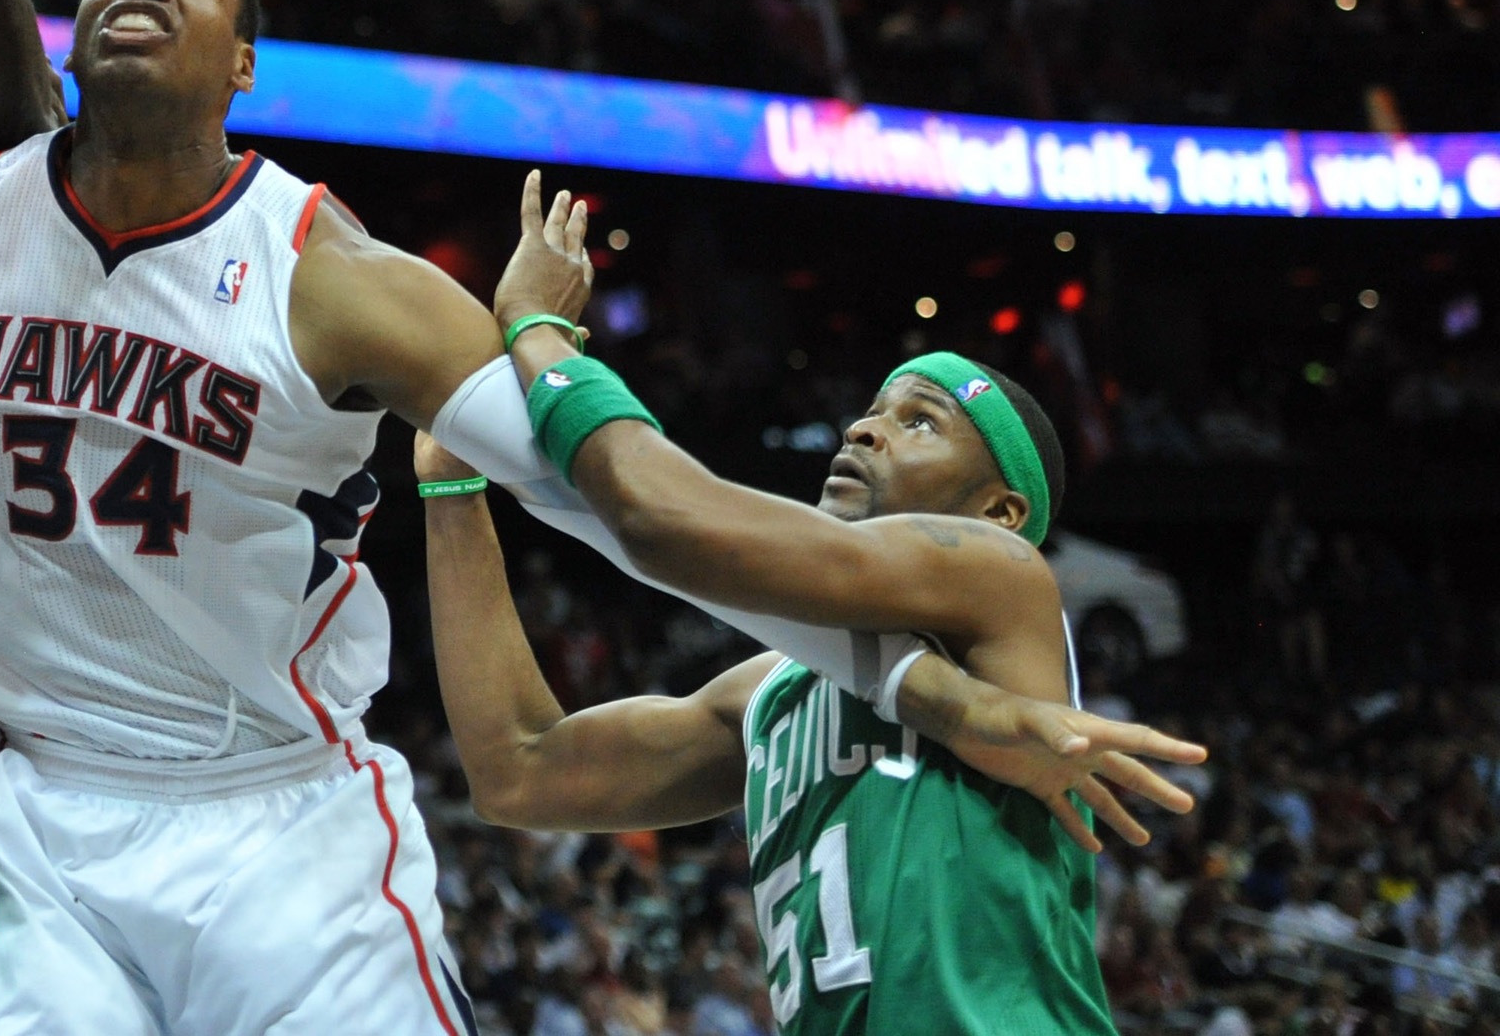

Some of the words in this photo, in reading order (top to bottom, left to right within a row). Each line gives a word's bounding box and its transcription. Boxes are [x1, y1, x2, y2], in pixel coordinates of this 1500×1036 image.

[1, 414, 192, 557] 34
[434, 485, 462, 493] JESUS
[753, 823, 873, 1027] 51
